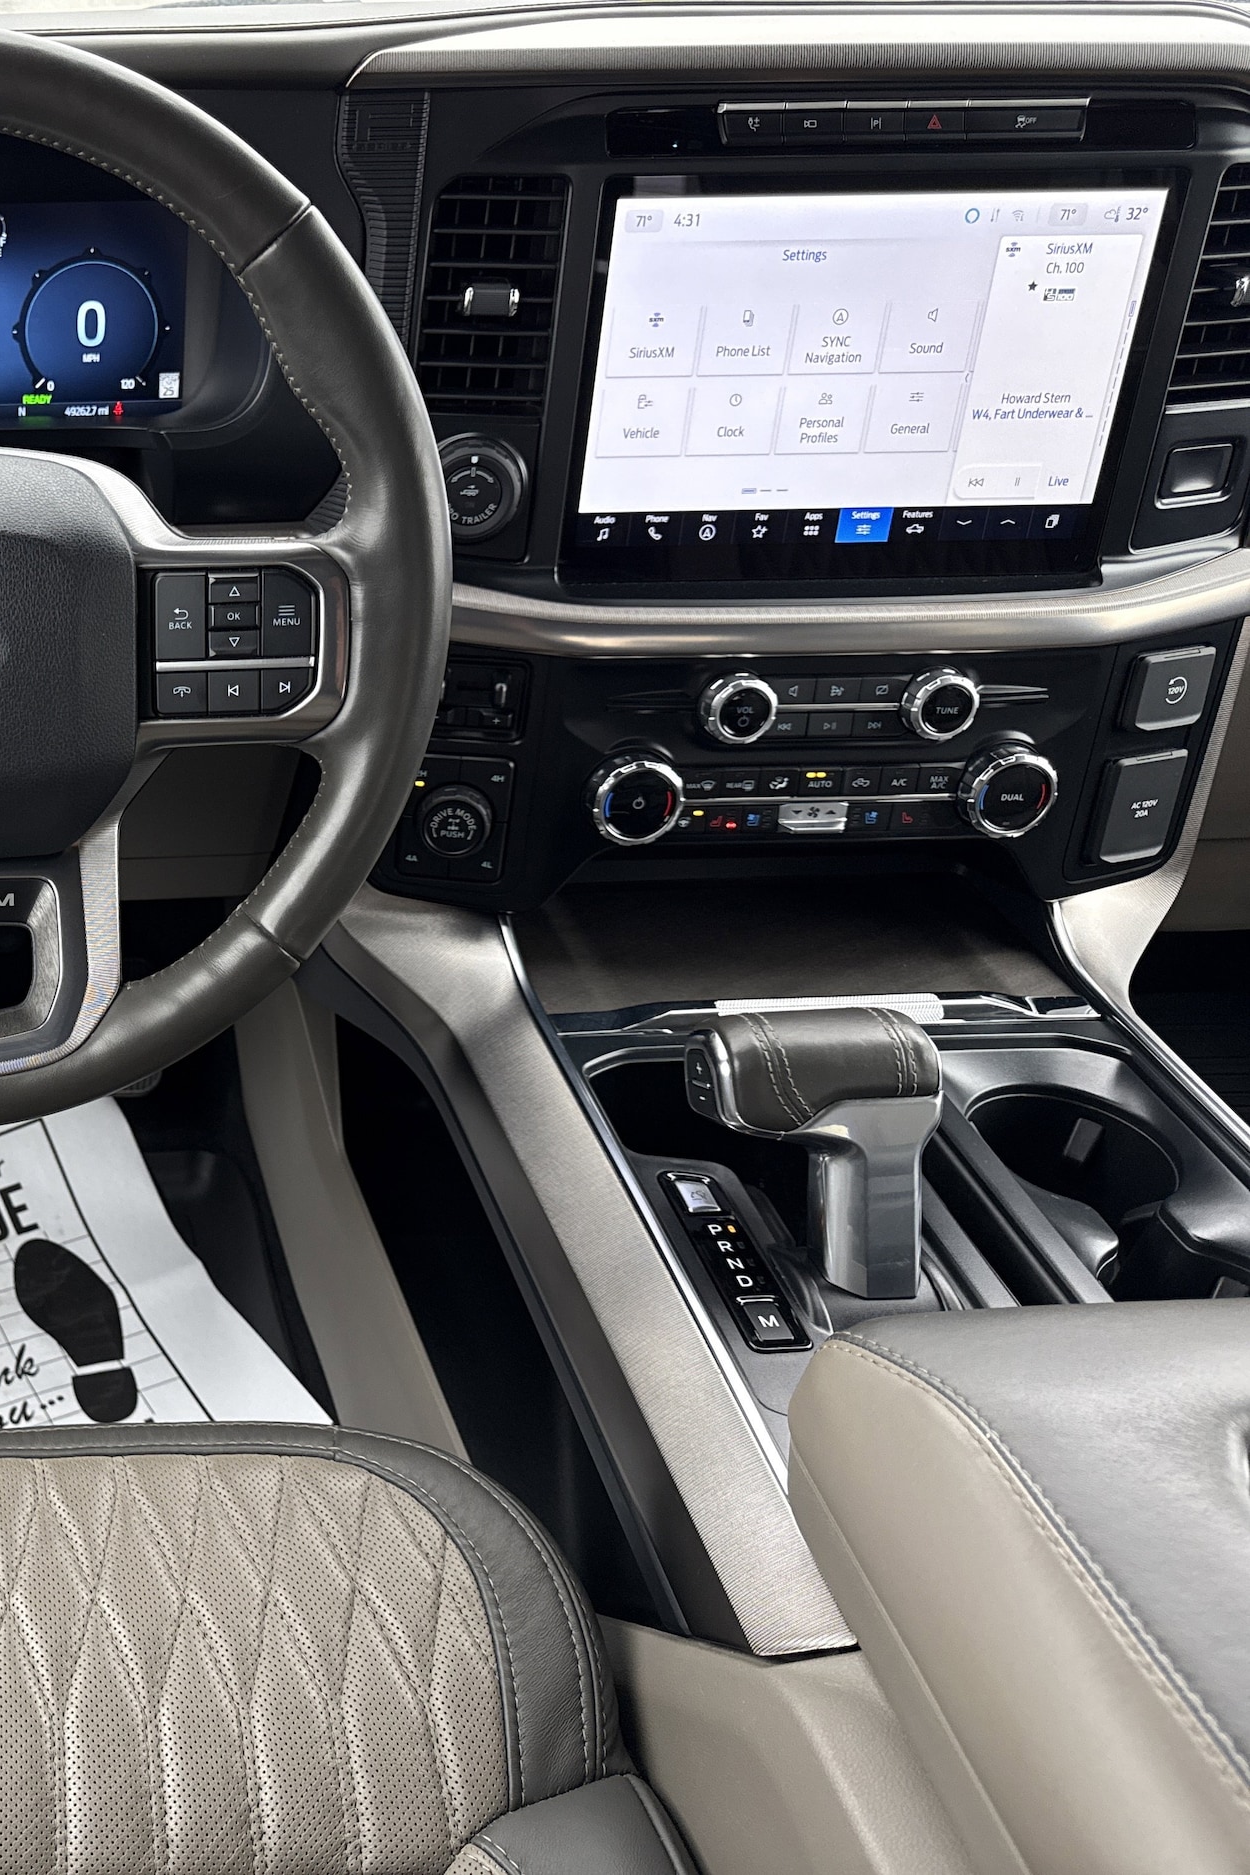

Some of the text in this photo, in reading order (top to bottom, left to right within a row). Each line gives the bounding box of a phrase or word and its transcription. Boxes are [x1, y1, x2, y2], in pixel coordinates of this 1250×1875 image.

[1025, 116, 1037, 125] OFF
[674, 213, 701, 227] 4:31
[0, 236, 7, 248] F
[1046, 242, 1093, 255] SiriusXM
[782, 249, 828, 262] Settings
[1046, 262, 1085, 274] Ch. 100
[76, 300, 106, 348] 0
[822, 336, 852, 348] SYNC
[629, 347, 675, 359] SiriusXM
[716, 345, 771, 357] Phone List
[909, 342, 944, 354] Sound
[82, 353, 100, 363] MPH
[805, 352, 862, 366] Navigation
[46, 381, 55, 392] 0
[120, 378, 135, 390] 120
[162, 386, 175, 397] 25
[22, 394, 52, 405] READY
[1001, 392, 1071, 404] Howard Stern
[972, 408, 992, 421] W4,
[993, 408, 1014, 420] Fart
[1017, 407, 1073, 419] Underwear
[1075, 407, 1084, 418] &
[799, 416, 845, 428] Personal
[623, 427, 660, 439] Vehicle
[717, 425, 745, 437] Clock
[890, 423, 930, 435] General
[800, 432, 838, 444] Profiles
[1048, 475, 1070, 487] Live
[461, 502, 498, 525] TRAILER
[645, 514, 670, 524] Phone
[702, 513, 718, 522] Nav
[754, 512, 770, 522] Fav
[804, 511, 823, 522] Apps
[851, 510, 881, 520] Settings
[902, 509, 934, 519] Features
[593, 515, 617, 525] Audio
[227, 612, 241, 621] OK
[272, 617, 301, 627] MENU
[168, 621, 193, 630] BACK
[1167, 685, 1185, 695] 120V
[736, 705, 754, 715] VOL
[935, 706, 960, 715] TUNE
[490, 774, 505, 783] 4H
[891, 778, 908, 787] A/C
[930, 775, 949, 783] MAX
[686, 782, 701, 790] MAX
[726, 782, 742, 790] REAR
[807, 780, 833, 789] AUTO
[930, 782, 947, 790] A/C
[1000, 793, 1025, 802] DUAL
[1131, 799, 1159, 810] AC 120V
[430, 808, 477, 831] DRIVE MODE
[1134, 810, 1149, 819] 20A
[440, 830, 465, 839] PUSH
[405, 854, 418, 862] 4A
[481, 861, 493, 869] 4L
[707, 1224, 722, 1236] P
[717, 1240, 735, 1253] R
[726, 1258, 745, 1270] N
[736, 1275, 754, 1288] D
[757, 1314, 780, 1328] M
